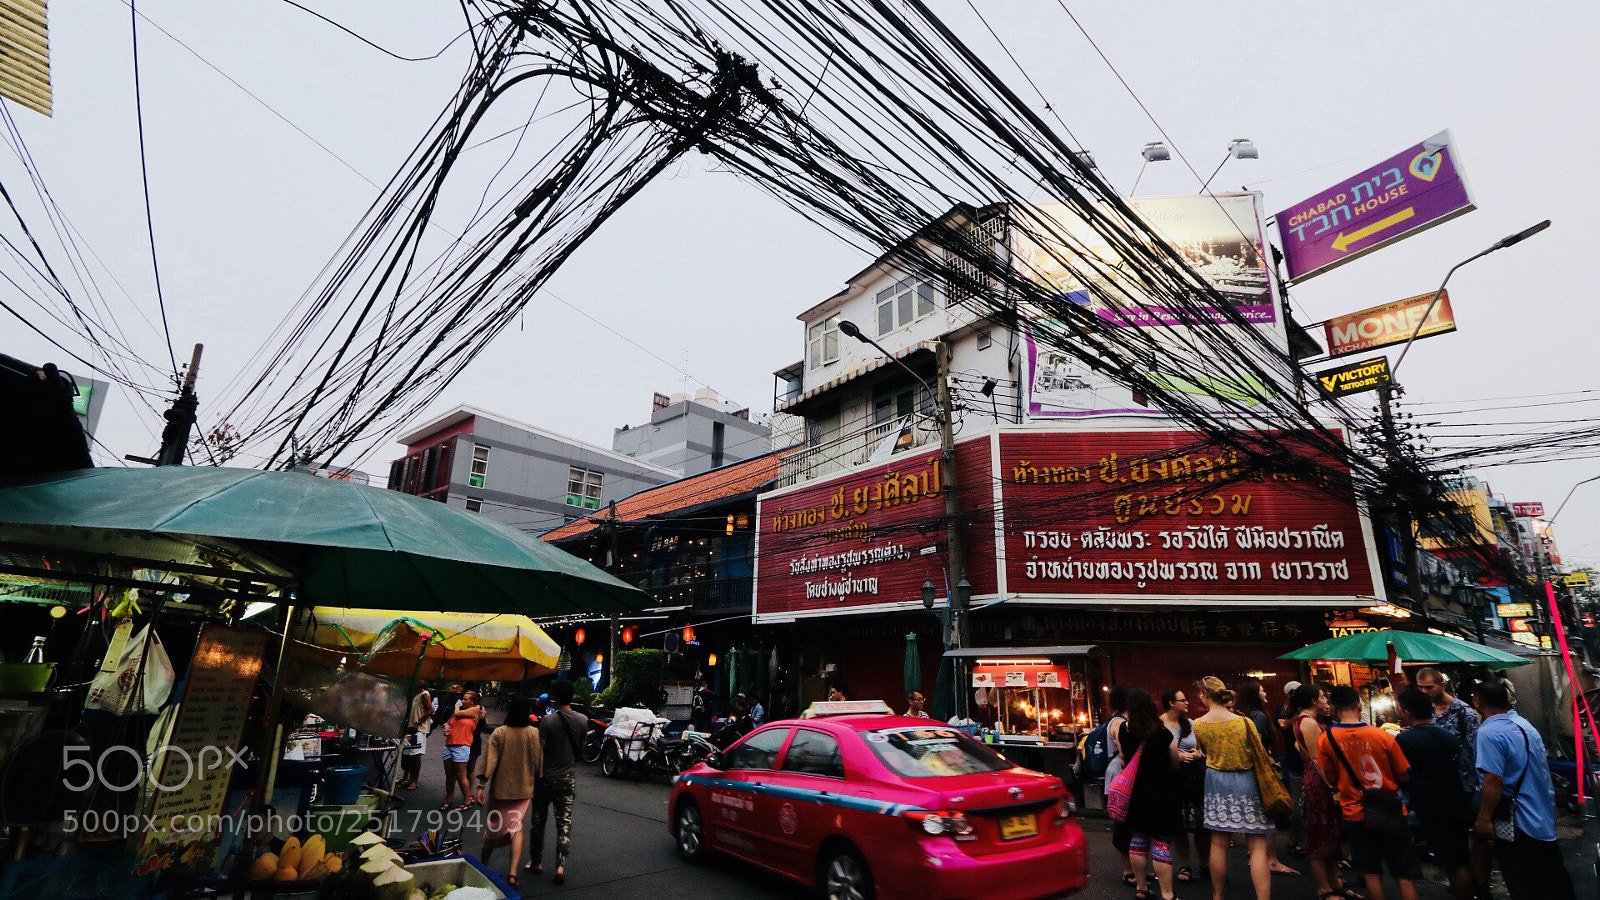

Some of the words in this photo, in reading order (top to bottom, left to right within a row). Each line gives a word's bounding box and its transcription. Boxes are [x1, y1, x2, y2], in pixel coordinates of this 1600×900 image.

[1350, 167, 1405, 204] בית
[1288, 193, 1347, 227] CHABAD
[1354, 184, 1409, 216] HOUSE
[1113, 311, 1137, 324] Say
[1331, 299, 1444, 347] MONEY
[1337, 362, 1386, 382] VICTORY
[1340, 380, 1365, 391] TATTOO
[1012, 459, 1092, 484] ห้างทอง
[773, 503, 827, 533] ห้างทอง
[1158, 524, 1231, 550] รอรับได้
[1225, 561, 1262, 581] จาก
[1271, 558, 1350, 581] เยาวราช
[1356, 753, 1384, 790] 9
